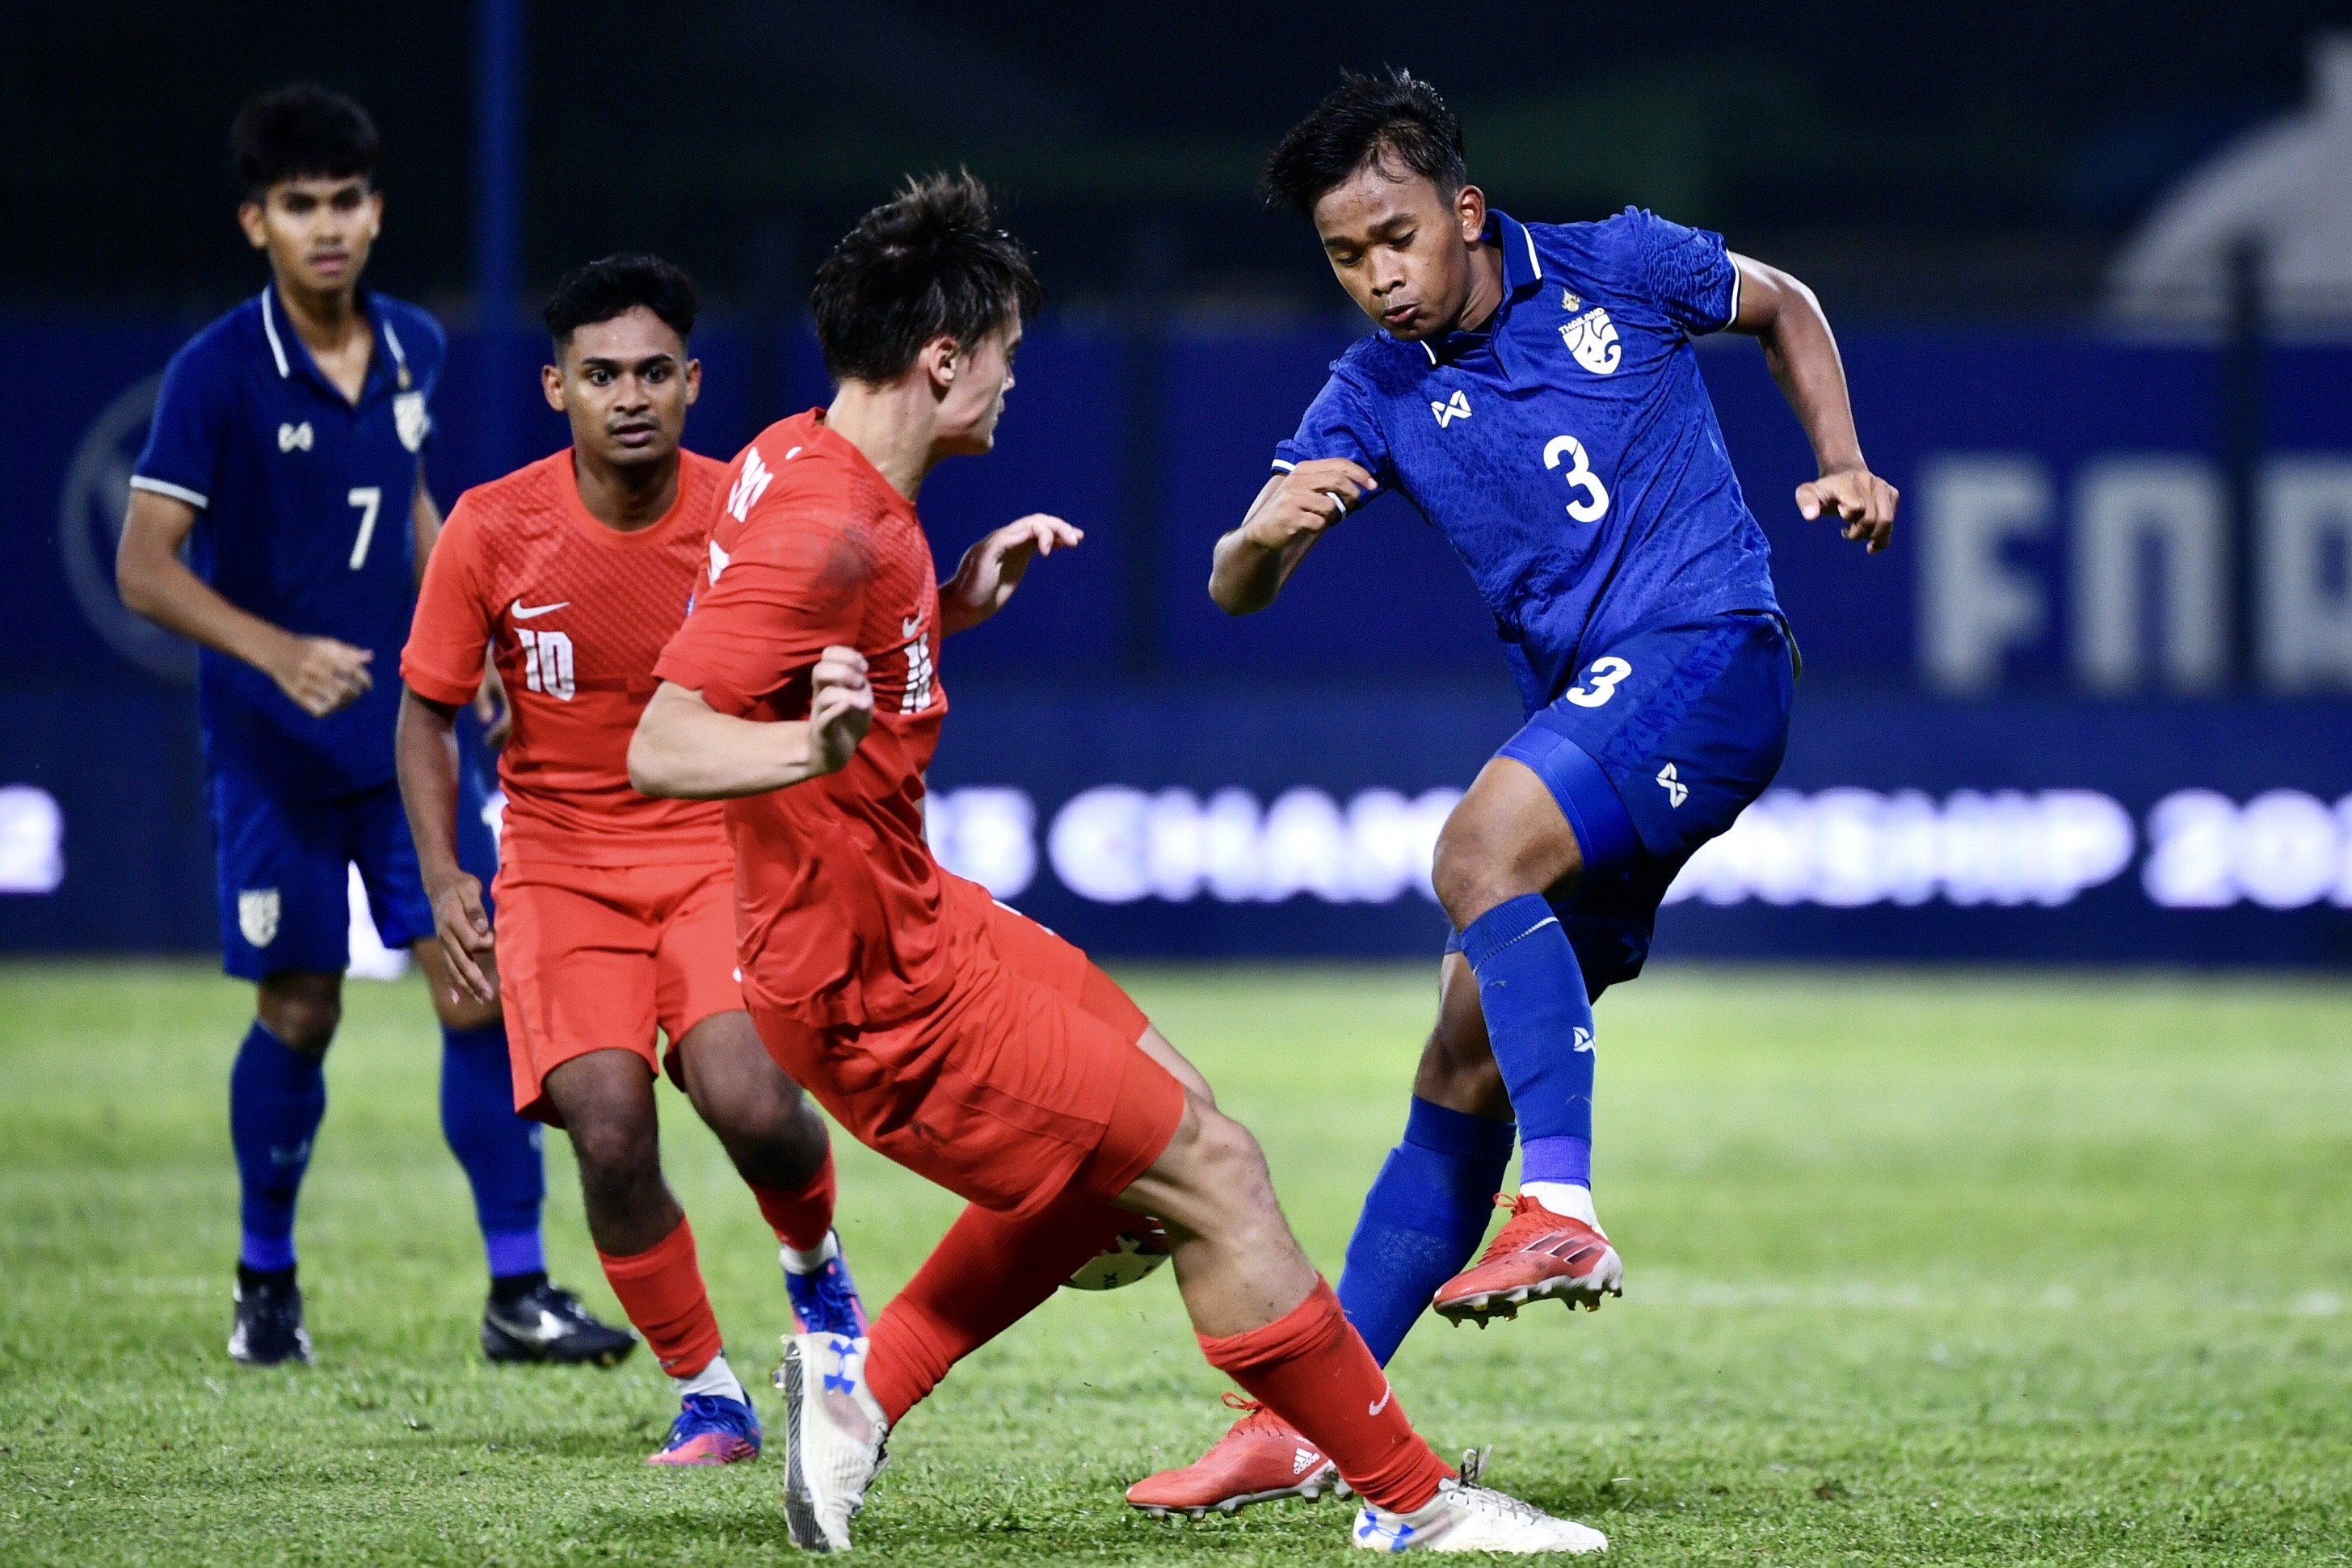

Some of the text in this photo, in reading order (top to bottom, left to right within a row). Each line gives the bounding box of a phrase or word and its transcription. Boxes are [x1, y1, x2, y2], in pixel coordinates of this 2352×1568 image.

[1558, 307, 1605, 334] THAILAND
[1543, 435, 1609, 523] 3
[347, 486, 381, 570] 7
[513, 627, 575, 702] 10
[1566, 656, 1632, 708] 3
[1293, 1452, 1320, 1475] adidas
